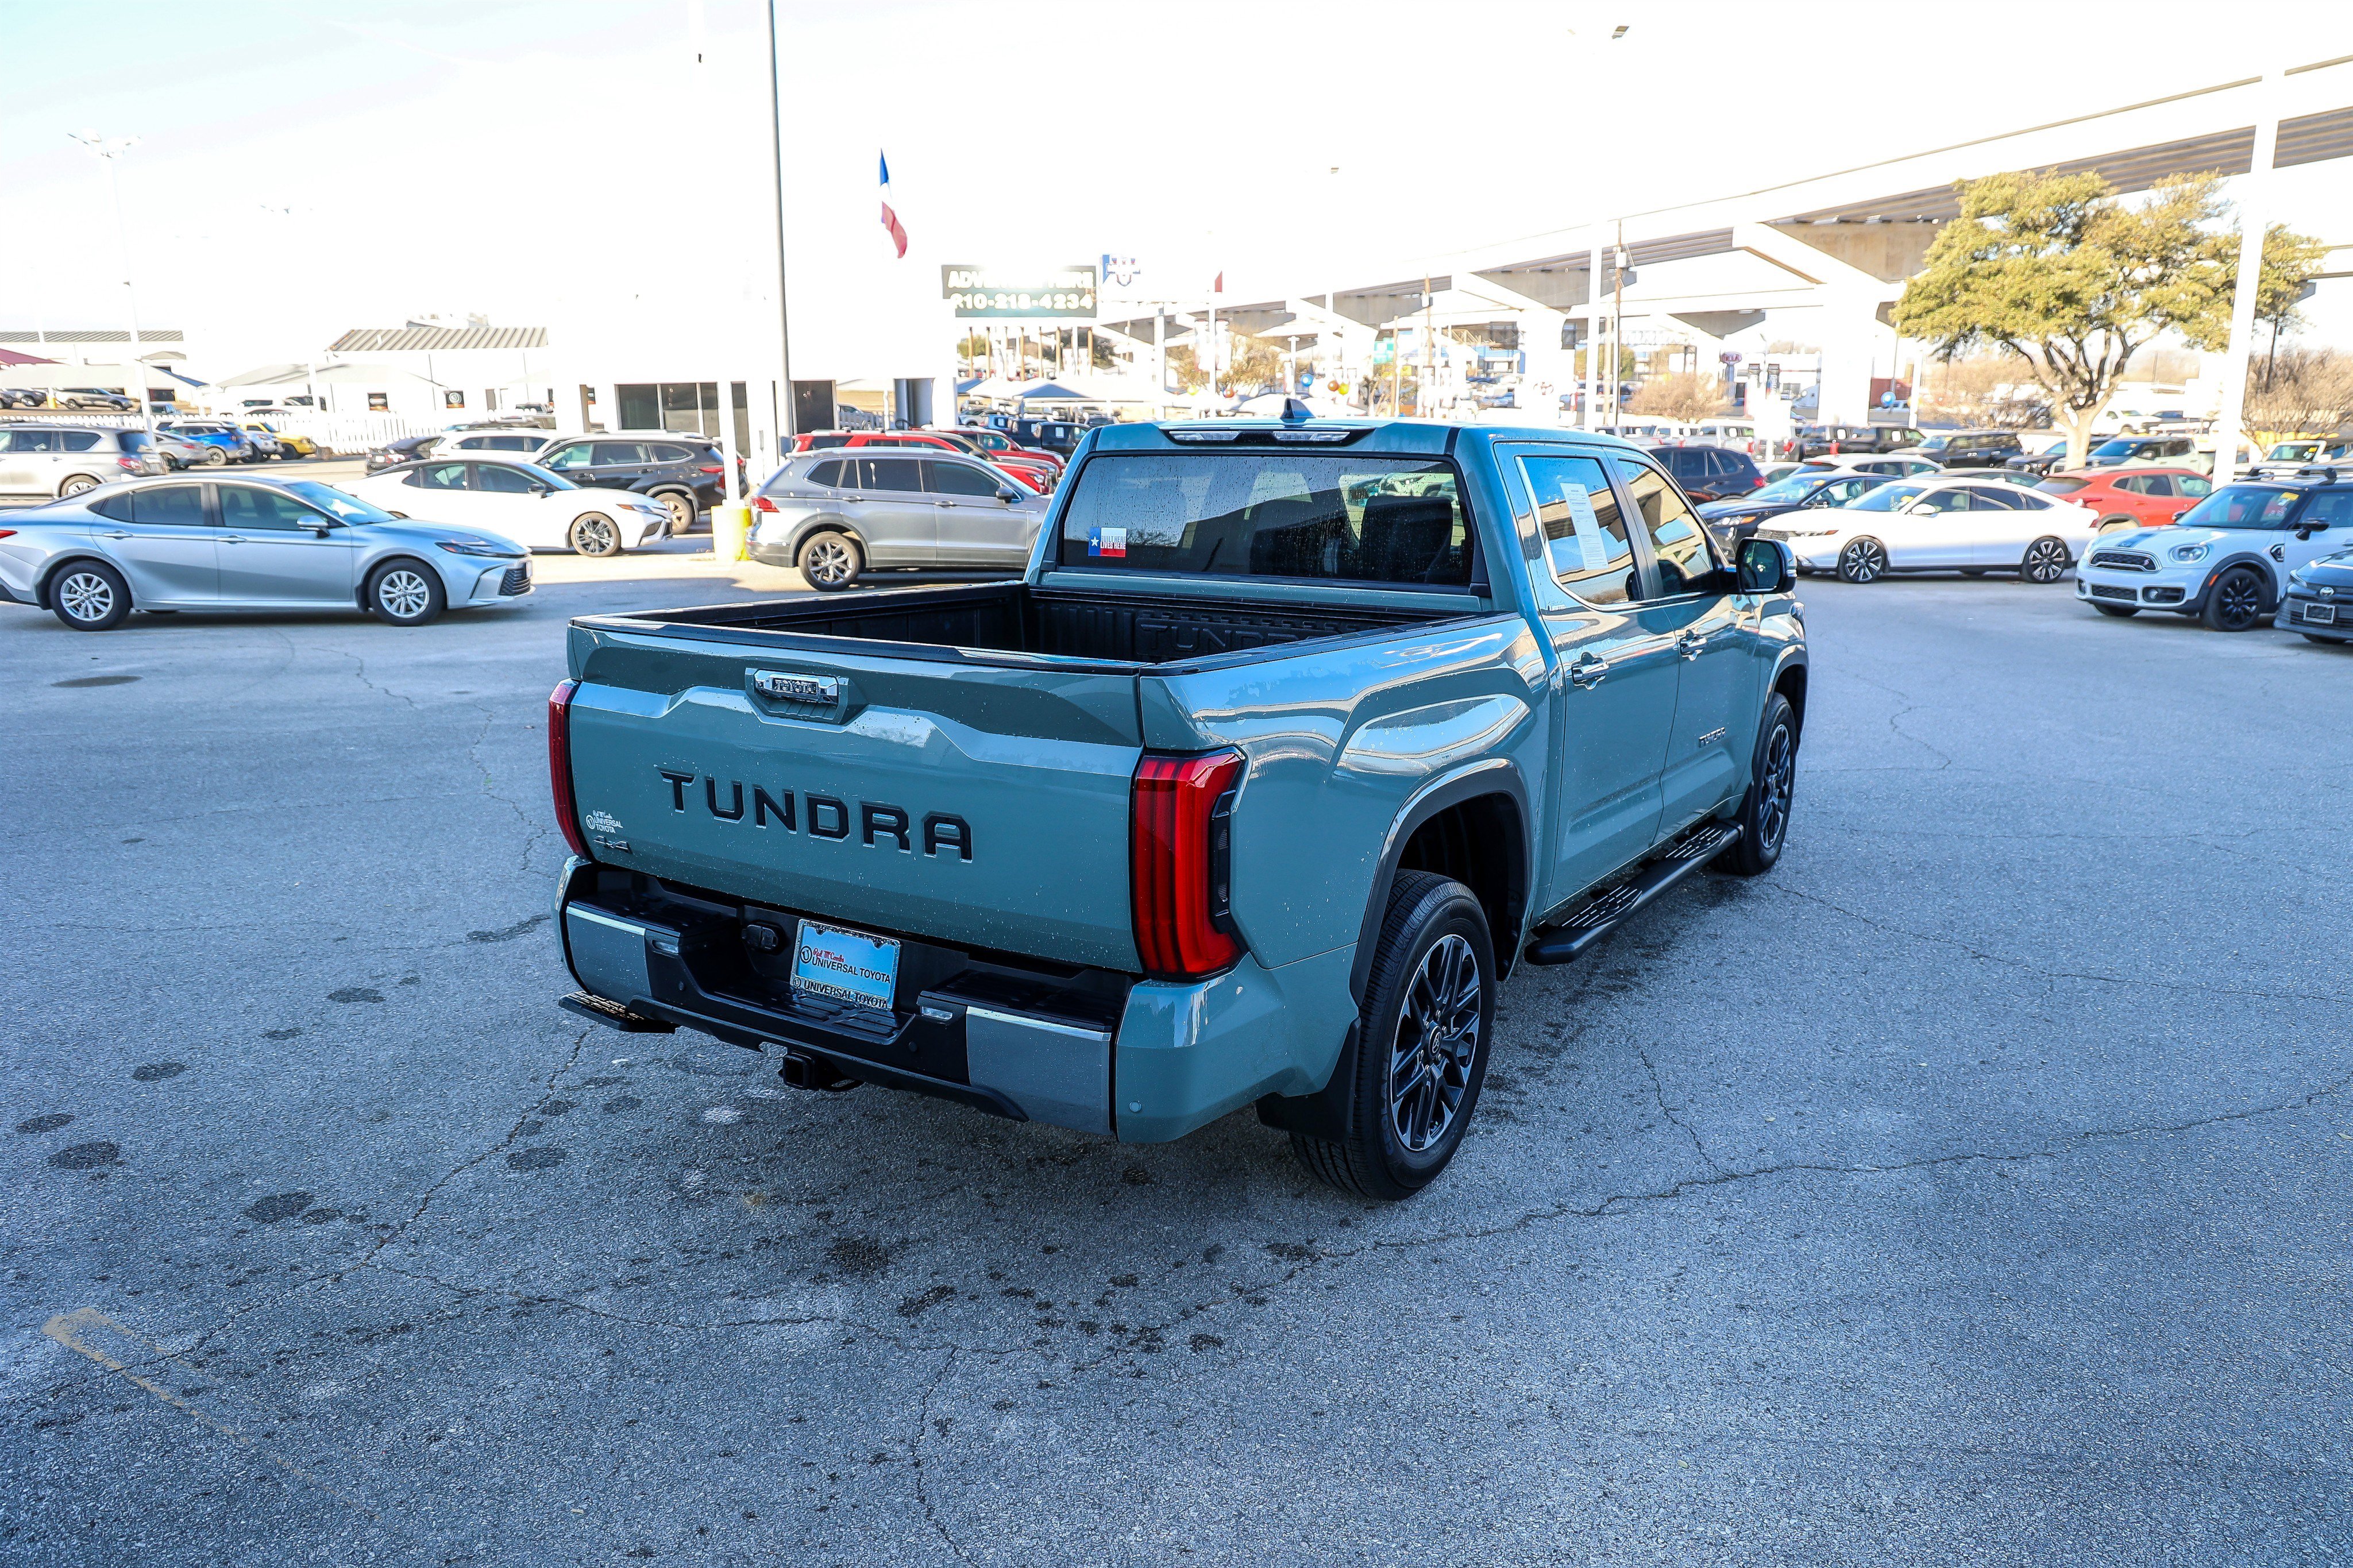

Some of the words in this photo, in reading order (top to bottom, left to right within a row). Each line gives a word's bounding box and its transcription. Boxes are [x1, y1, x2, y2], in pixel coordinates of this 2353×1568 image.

[1100, 541, 1113, 549] LIVES
[1114, 542, 1126, 550] HERE
[774, 679, 816, 694] TOYOTA
[659, 768, 973, 863] TUNDRA
[594, 817, 623, 828] UNIVERSAL
[596, 824, 616, 833] TOYOTA
[813, 948, 823, 960] Red
[812, 956, 858, 976] UNIVERSAL
[859, 968, 890, 984] TOYOTA
[804, 979, 853, 1001] UNIVERSAL
[854, 993, 889, 1009] TOYOTA
